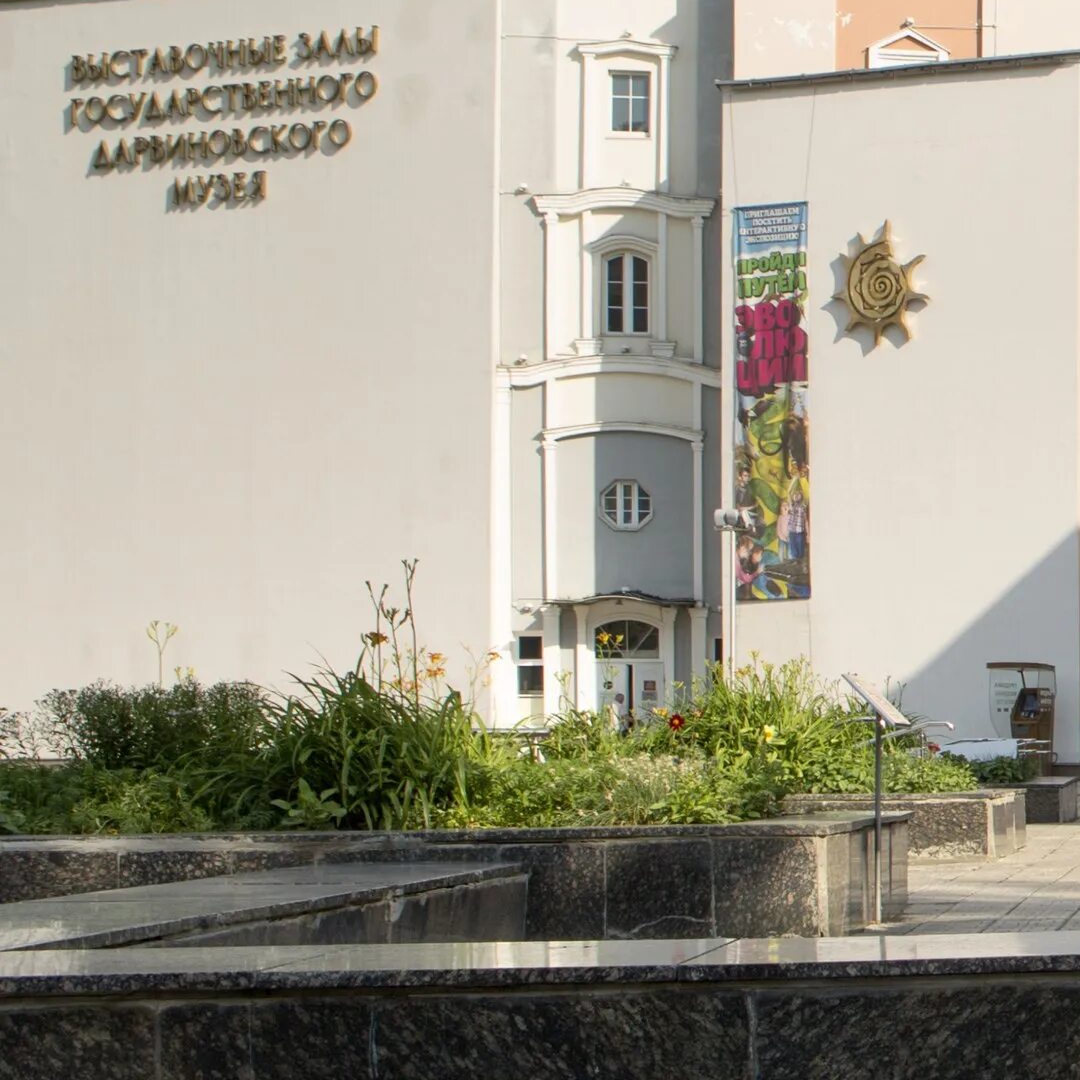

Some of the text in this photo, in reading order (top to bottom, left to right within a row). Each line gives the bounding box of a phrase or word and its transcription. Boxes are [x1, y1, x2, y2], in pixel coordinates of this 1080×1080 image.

[71, 25, 380, 82] ВЫСТАВОЧНЫЕ ЗАЛЫ
[69, 71, 379, 127] ГОСУДАРСТВЕННОГО
[92, 118, 353, 170] ДАРВИНОВСКОГО
[172, 170, 268, 207] МУЗЕЯ
[744, 206, 800, 219] ПРИГЛАШАЕМ
[752, 216, 793, 227] ПОСЕТИТЬ
[737, 251, 807, 275] ПРОЙДИ
